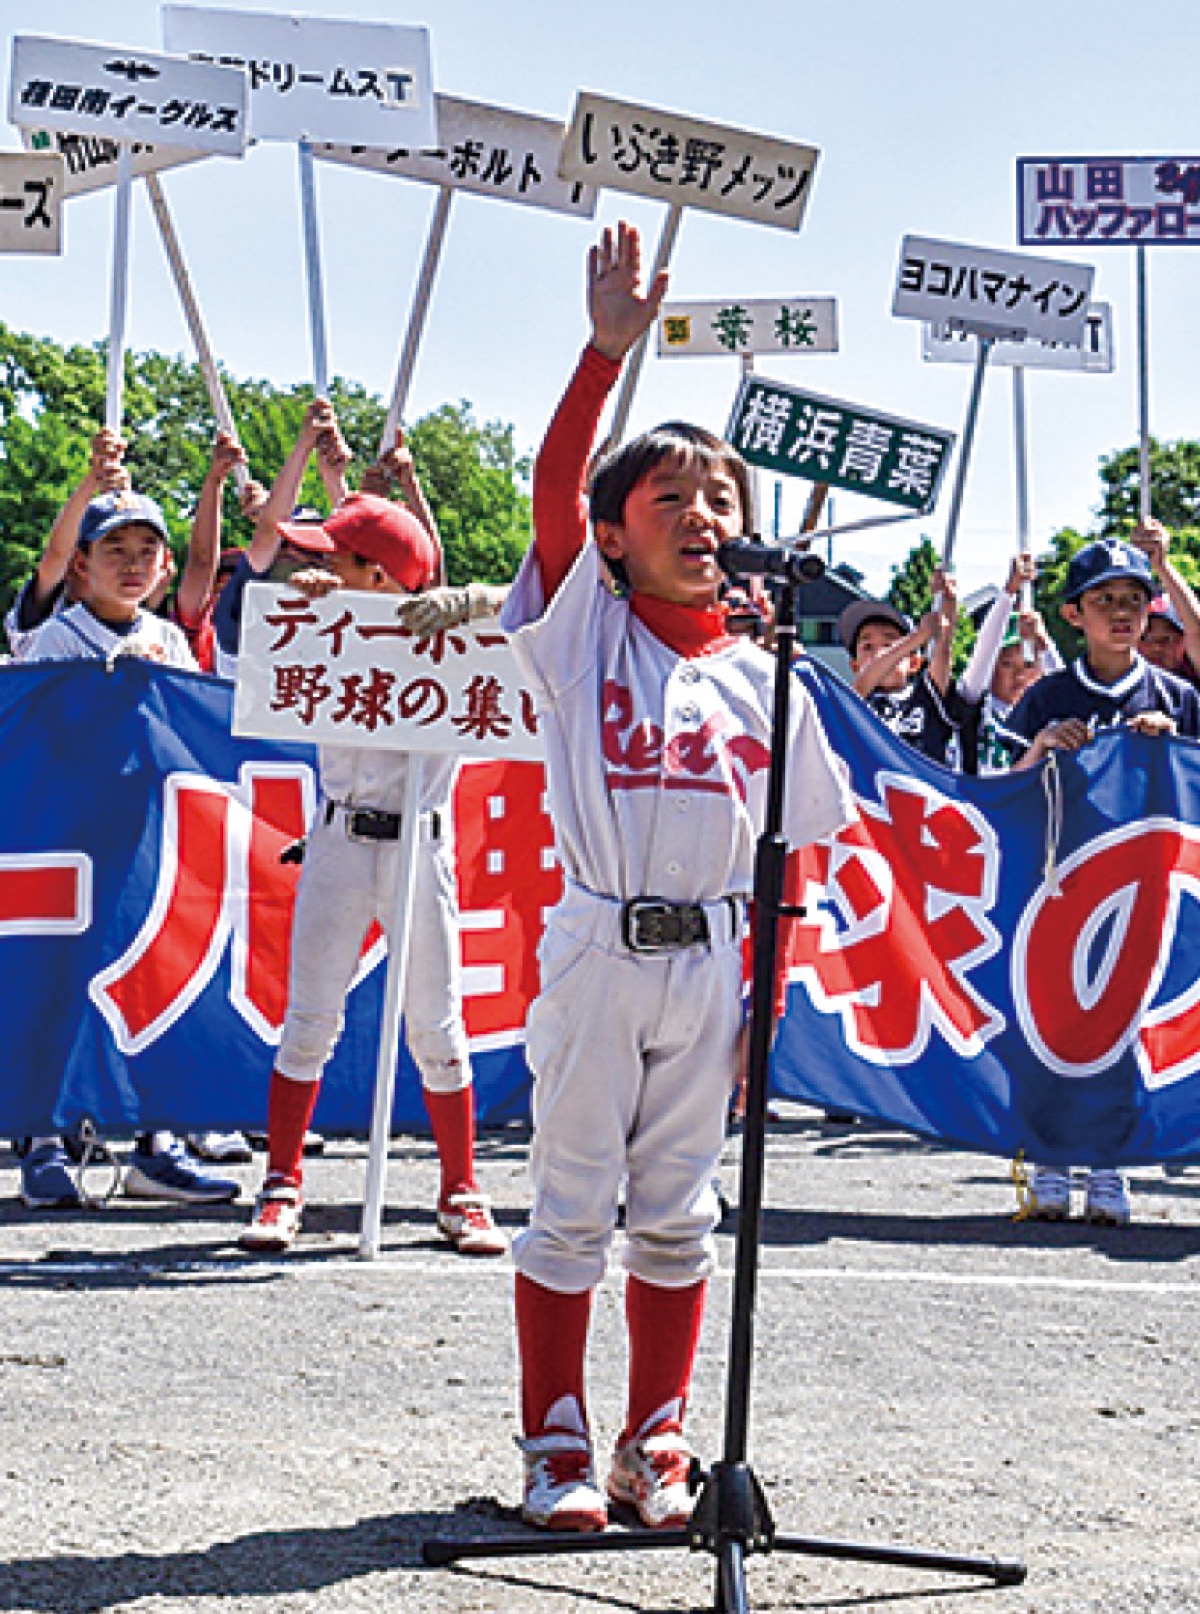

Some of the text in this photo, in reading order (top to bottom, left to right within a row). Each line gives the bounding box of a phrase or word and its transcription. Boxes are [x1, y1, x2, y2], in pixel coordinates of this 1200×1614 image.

[188, 53, 413, 101] ドリームスT
[581, 112, 811, 209] いぶき野メッツ
[1036, 163, 1123, 200] 山田
[899, 258, 1087, 317] ヨコハマナイン
[741, 390, 942, 498] 横浜青葉
